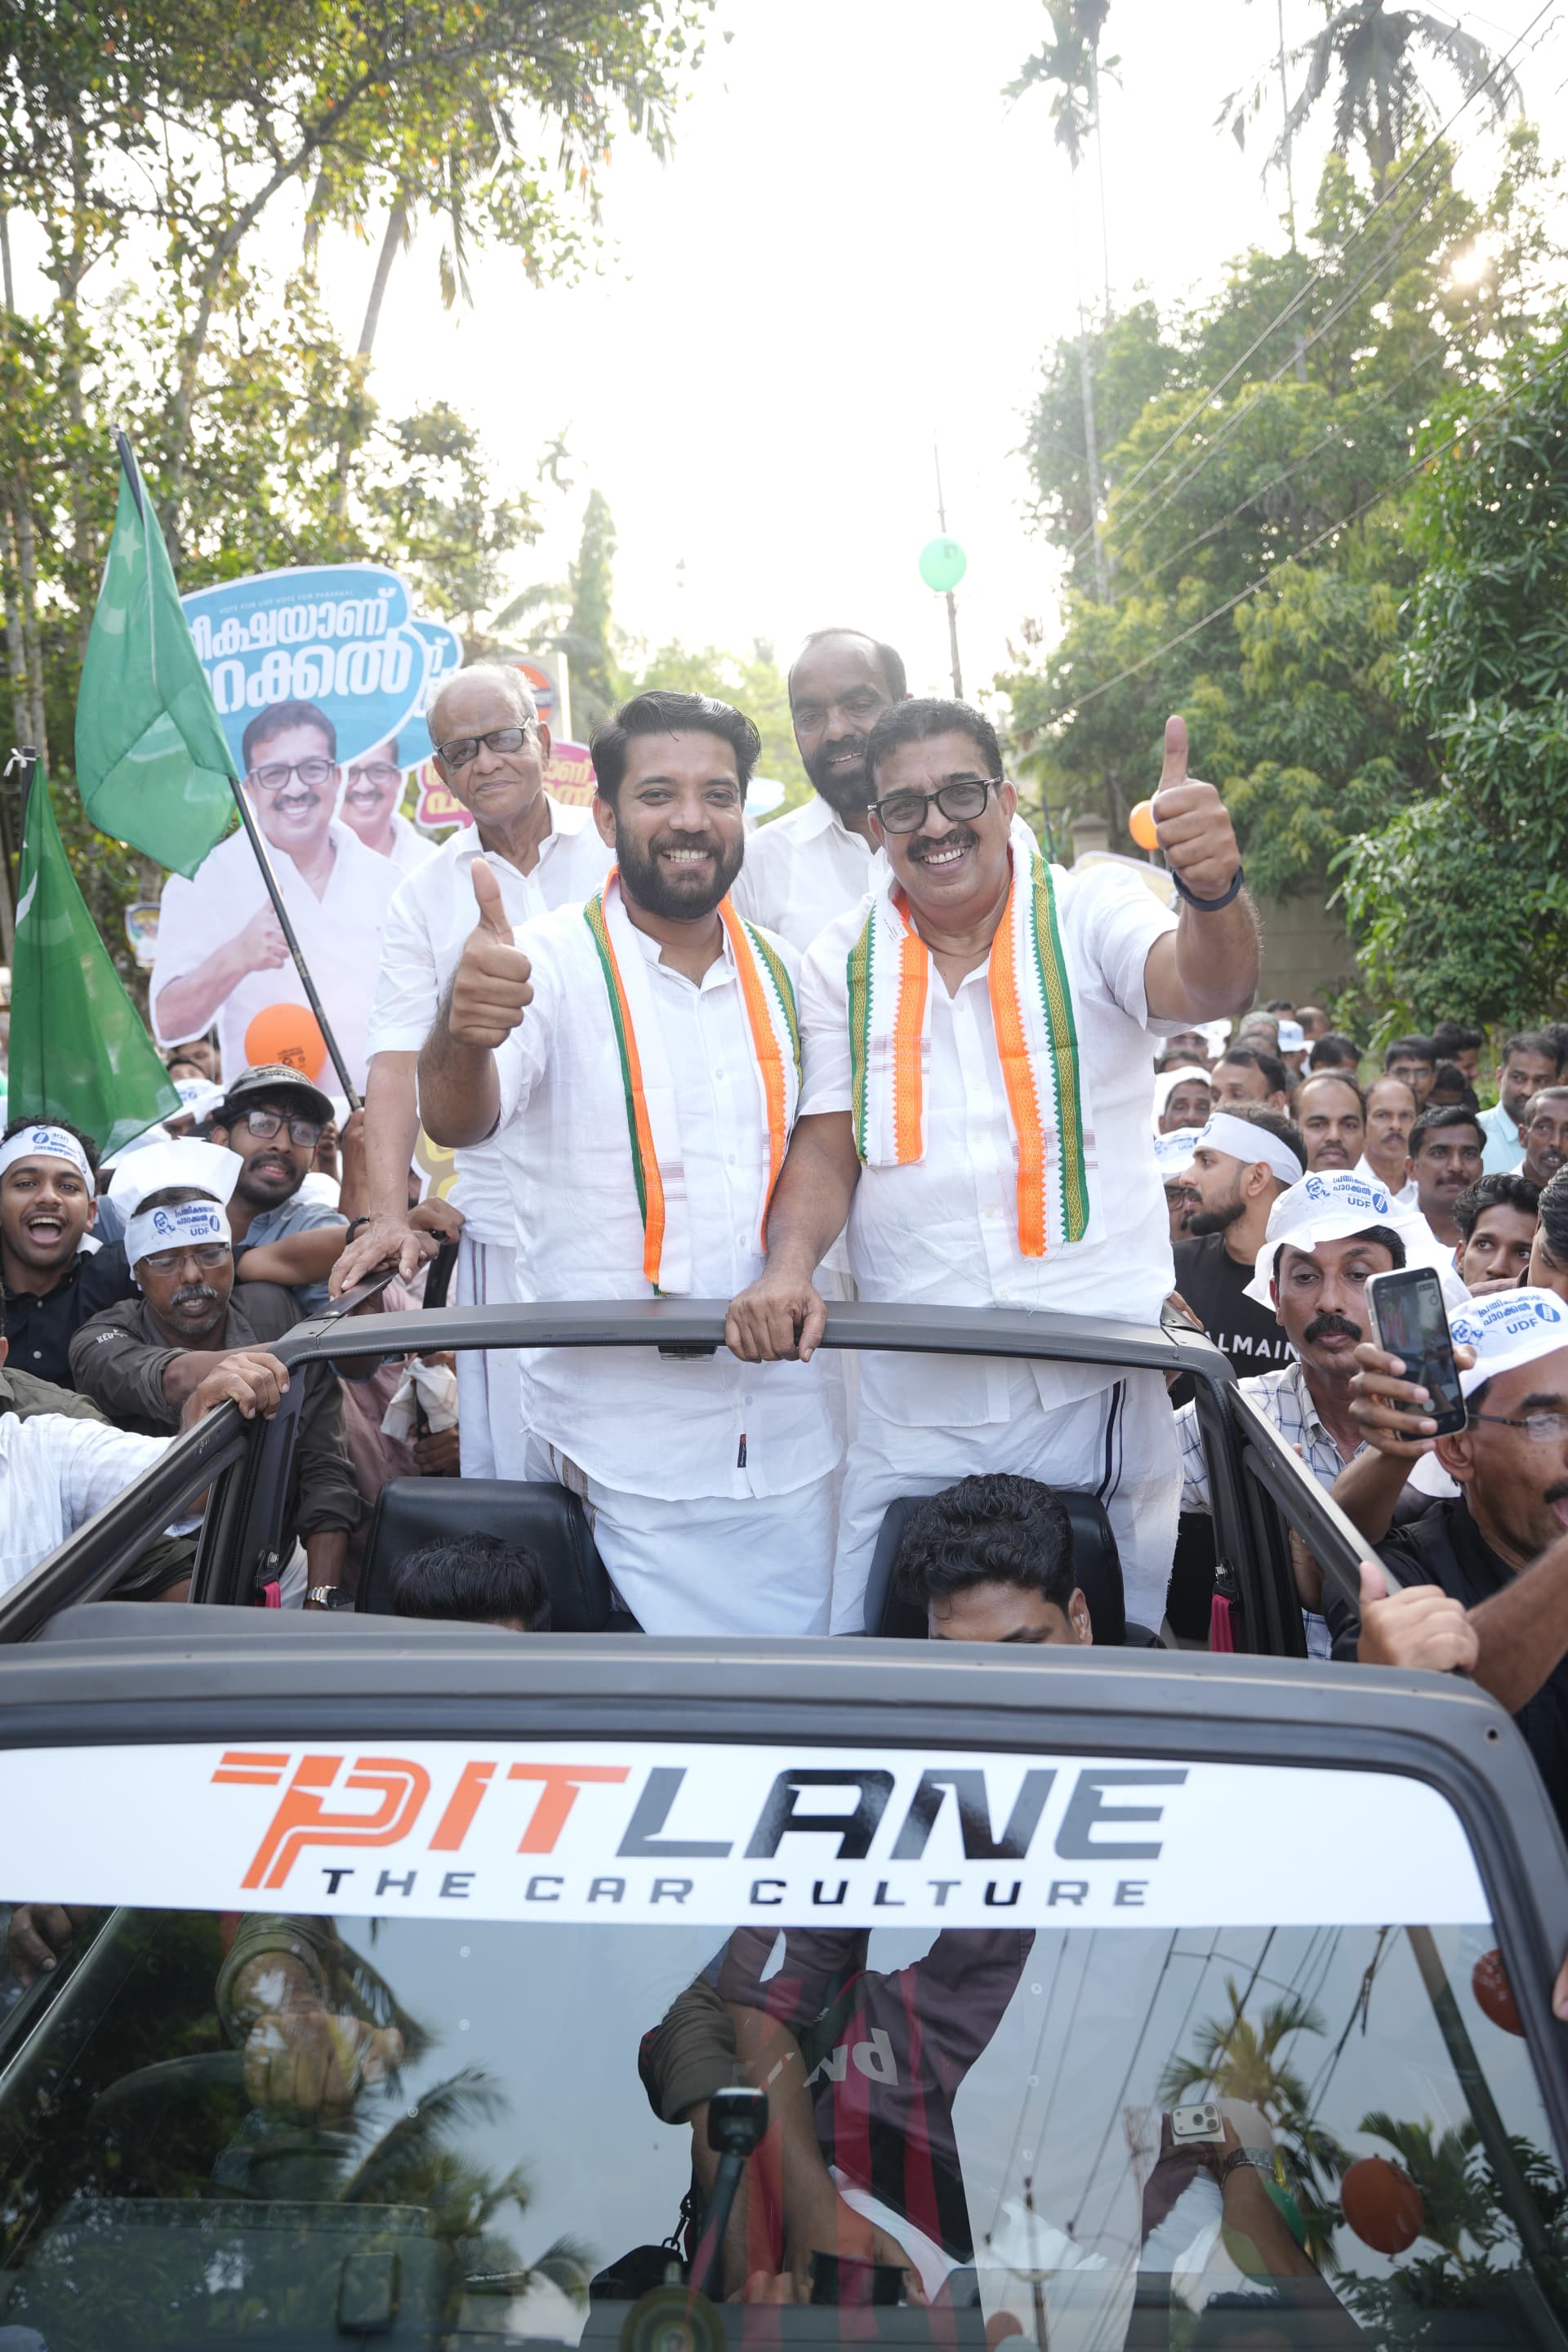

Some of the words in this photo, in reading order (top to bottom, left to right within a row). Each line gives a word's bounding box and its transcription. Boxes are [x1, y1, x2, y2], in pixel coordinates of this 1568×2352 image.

[1348, 1196, 1372, 1209] UDF
[190, 1227, 210, 1236] UDF
[1507, 1318, 1539, 1334] UDF
[211, 1752, 1190, 1889] PITLANE
[321, 1869, 476, 1899] THE
[524, 1875, 694, 1904] CAR
[749, 1879, 1150, 1907] CULTURE
